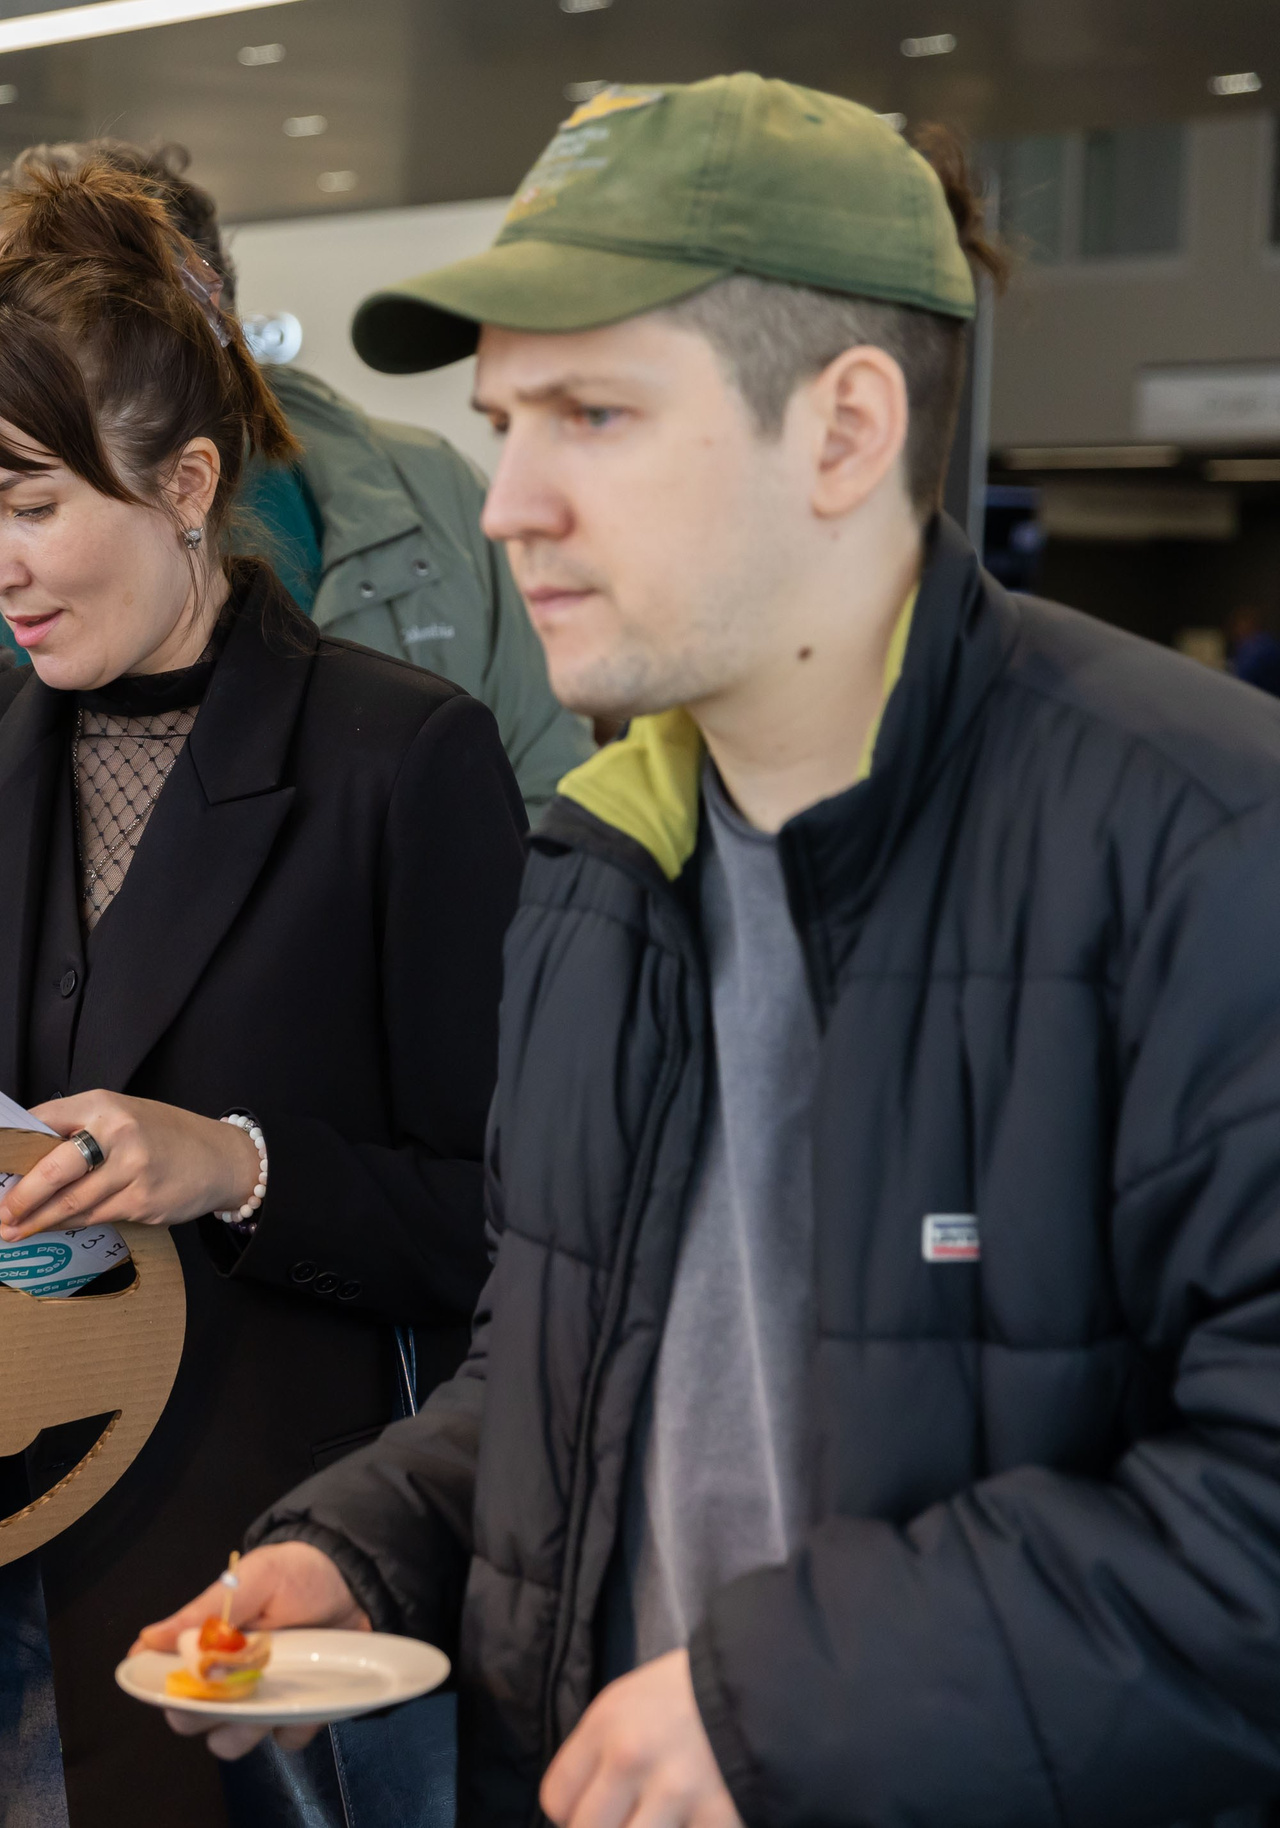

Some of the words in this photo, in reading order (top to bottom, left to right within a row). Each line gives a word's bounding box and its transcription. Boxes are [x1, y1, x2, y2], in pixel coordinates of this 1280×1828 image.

[81, 1234, 106, 1250] 3
[37, 1247, 65, 1255] PRO
[36, 1257, 66, 1274] Тебя
[26, 1284, 60, 1295] Тебя
